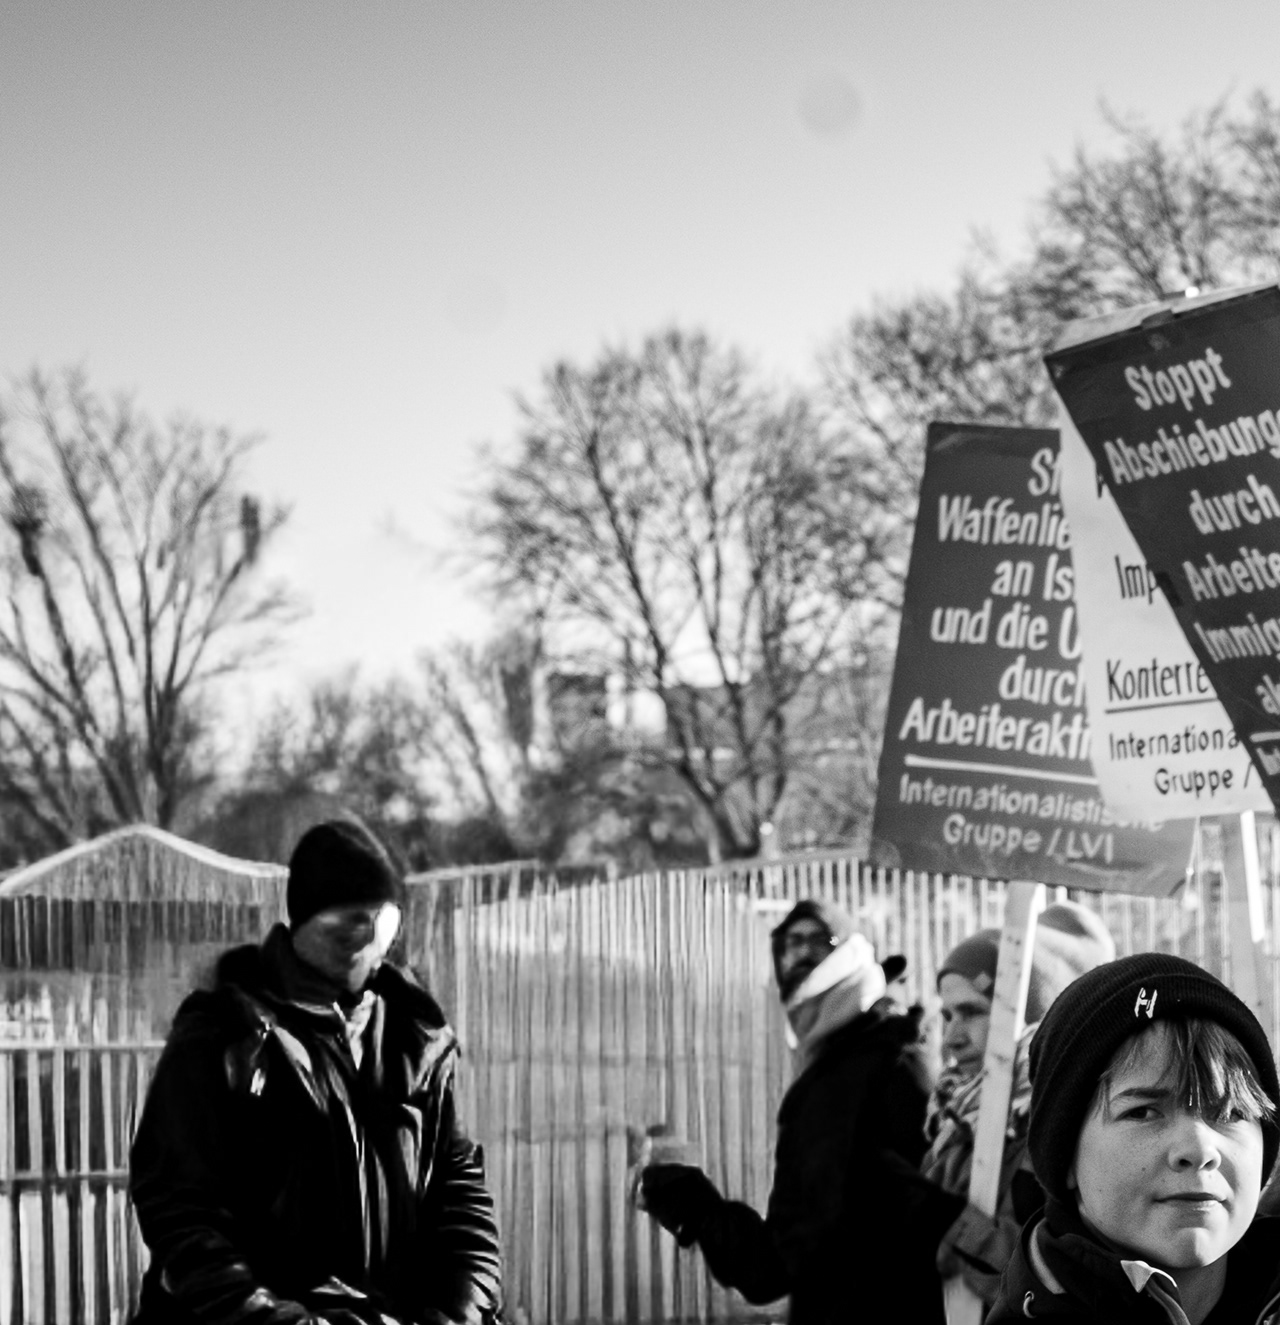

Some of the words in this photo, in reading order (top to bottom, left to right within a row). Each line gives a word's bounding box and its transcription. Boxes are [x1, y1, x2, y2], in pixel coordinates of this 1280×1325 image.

[1124, 347, 1232, 410] Stoppt
[939, 496, 1072, 550] Waffenlie
[992, 560, 1033, 597] an
[931, 599, 991, 643] und
[997, 605, 1048, 650] die
[900, 698, 1094, 761] Arbeiterakti
[1109, 725, 1239, 761] Internationa
[1154, 767, 1233, 799] Gruppe
[943, 813, 1042, 855] Gruppe
